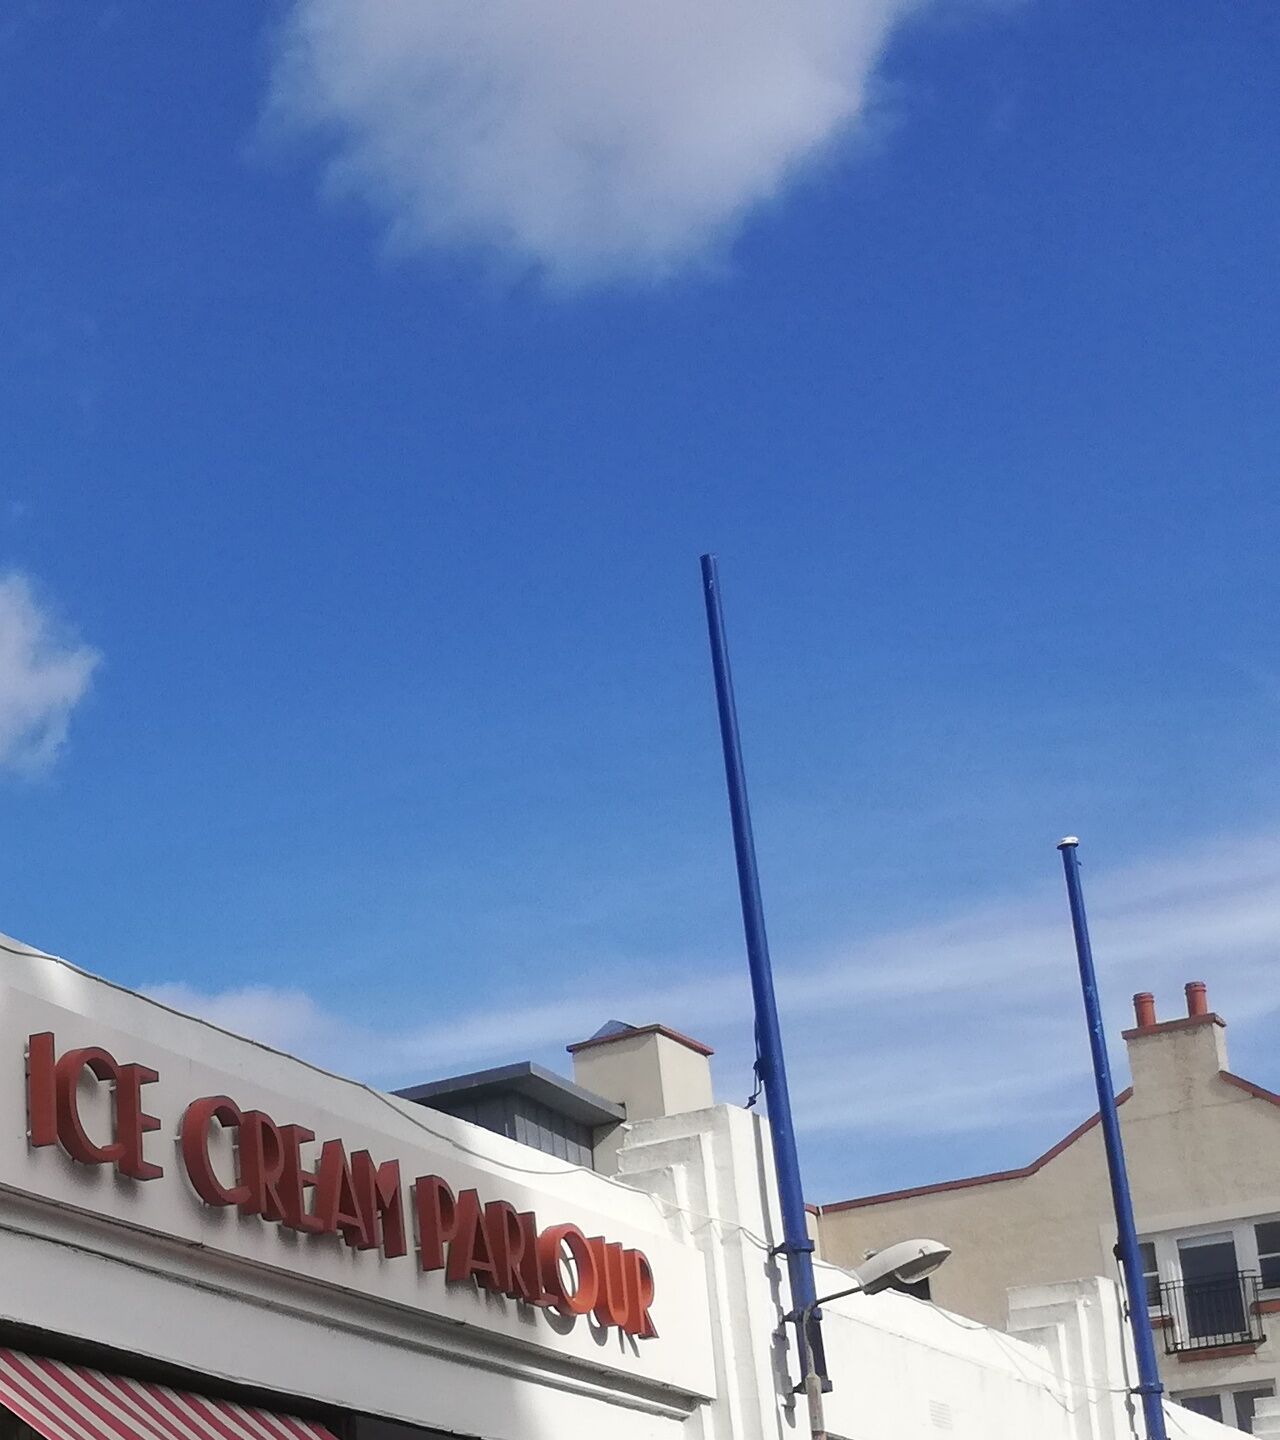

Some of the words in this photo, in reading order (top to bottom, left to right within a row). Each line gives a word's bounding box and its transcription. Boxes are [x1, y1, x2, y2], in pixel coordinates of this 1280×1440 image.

[28, 1031, 164, 1181] ICE
[181, 1095, 408, 1259] CREAM
[415, 1175, 660, 1340] PARLOUR
